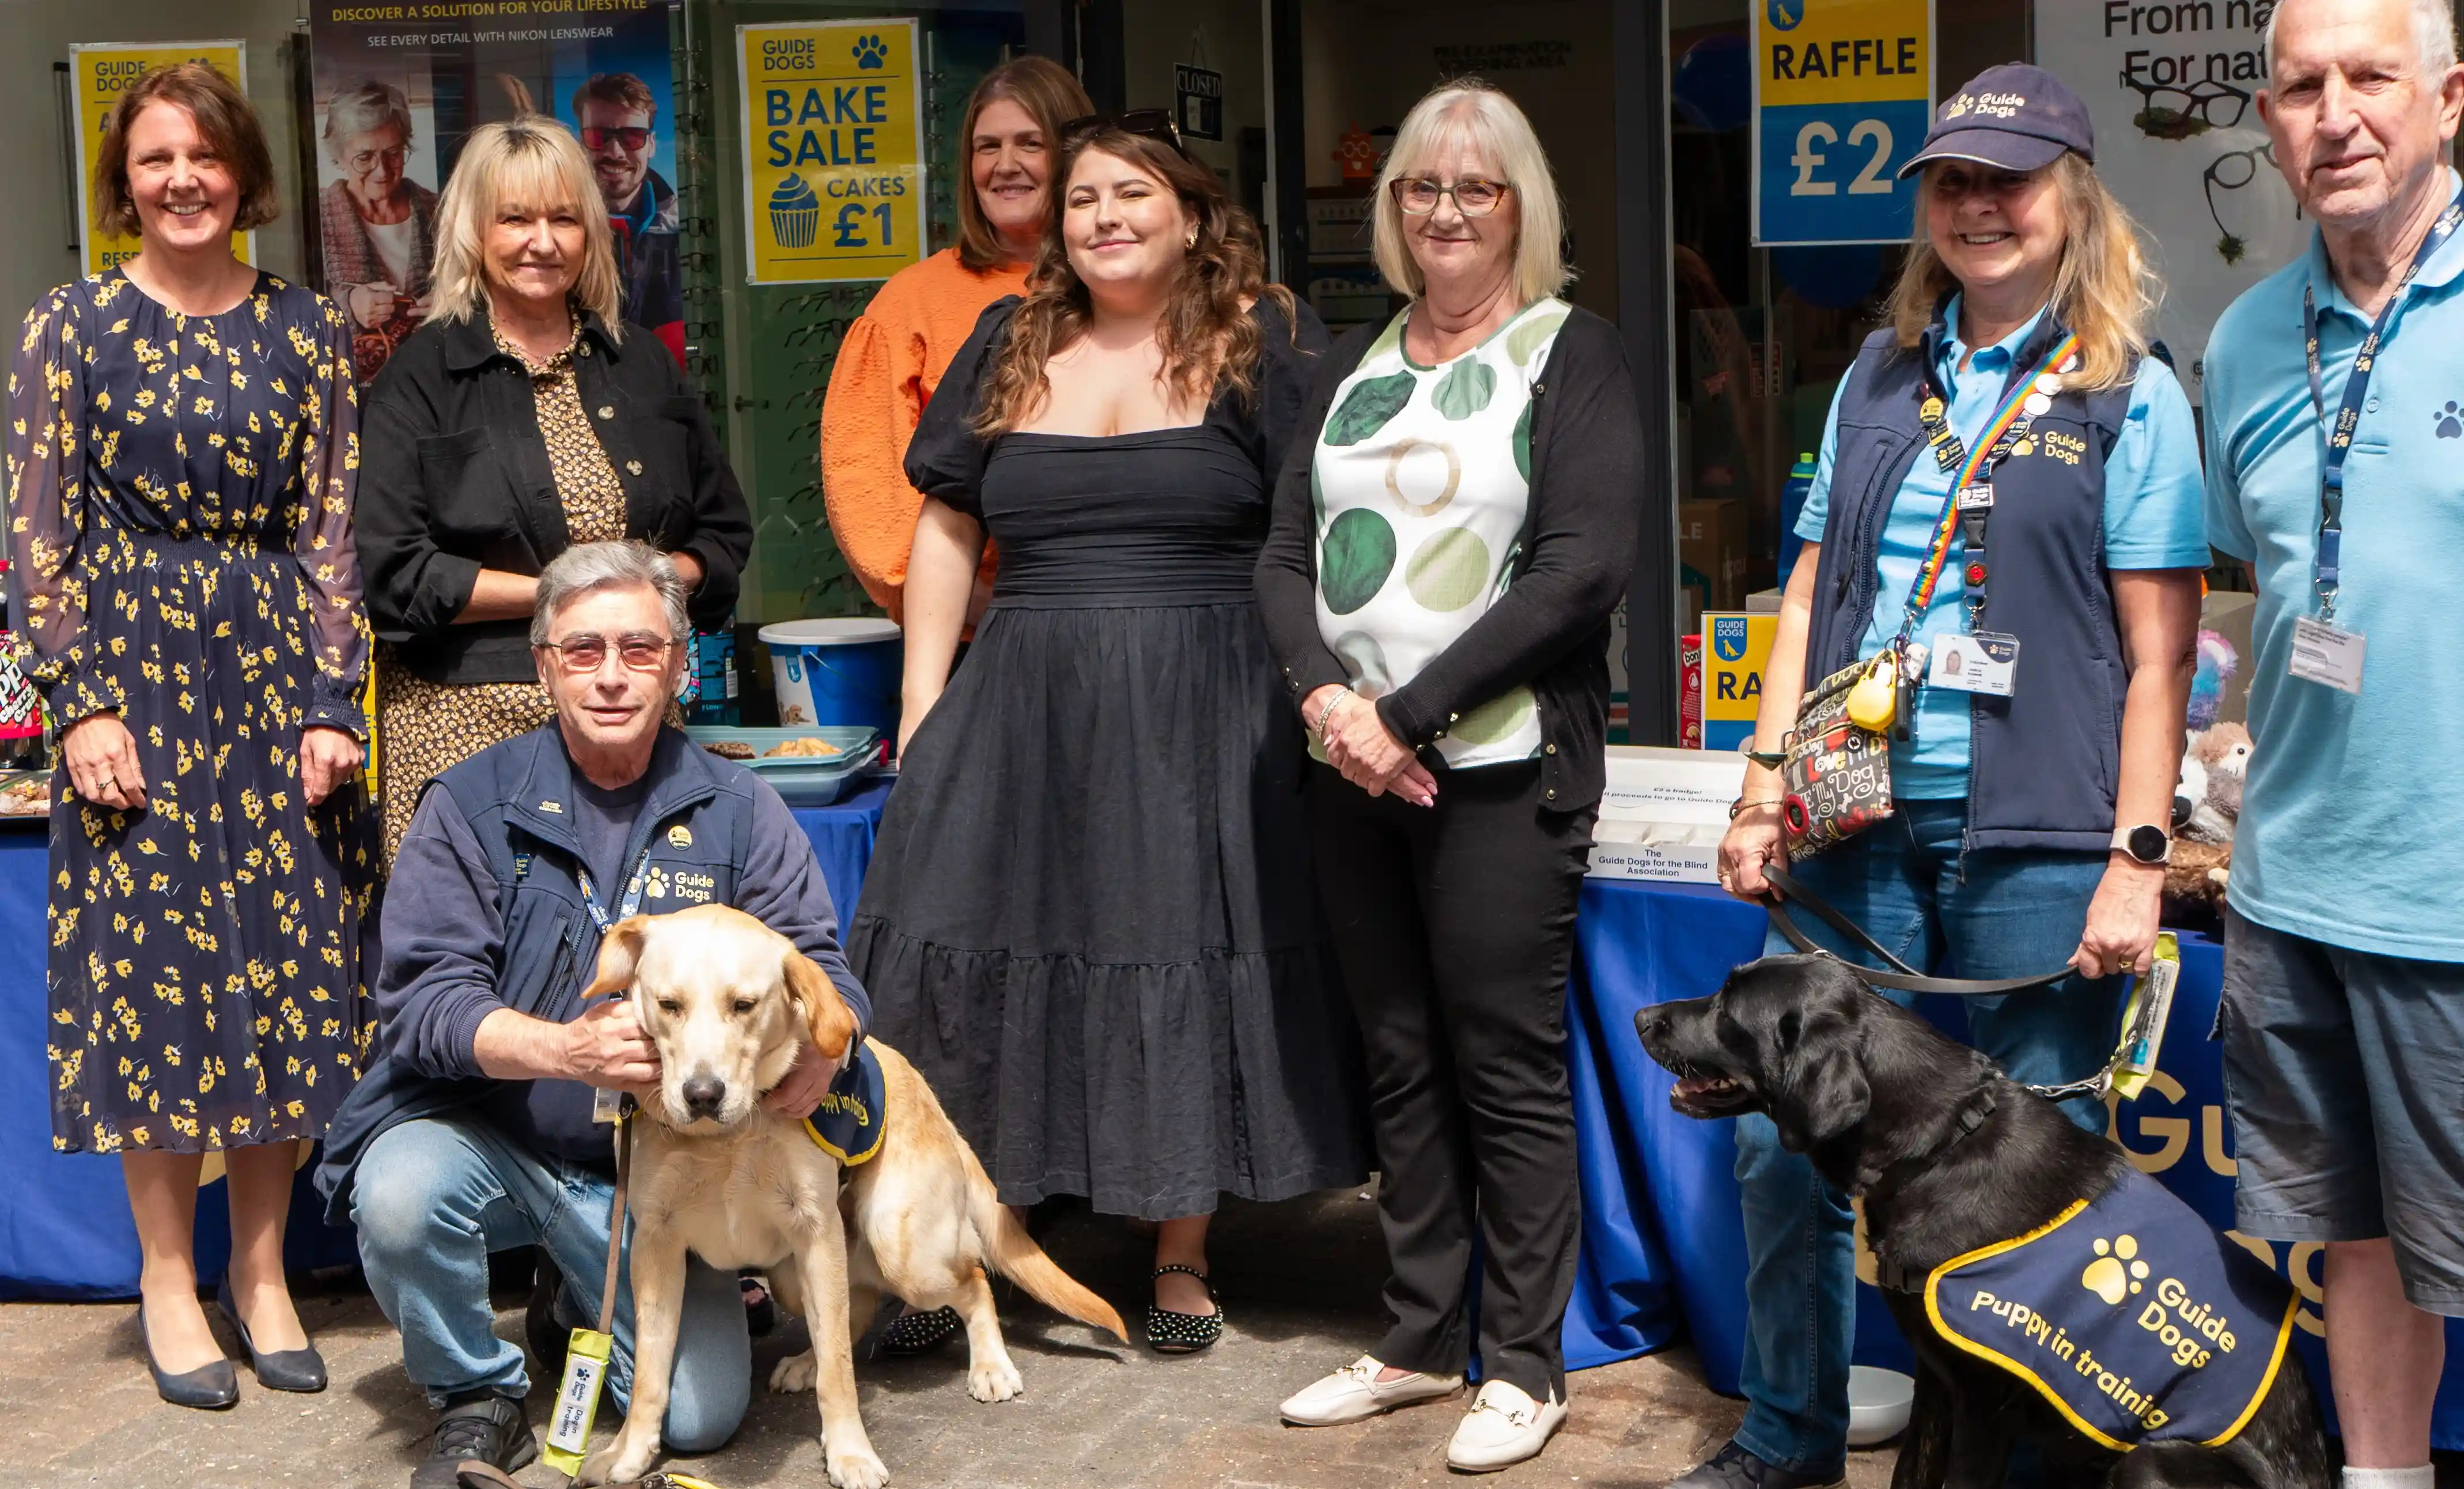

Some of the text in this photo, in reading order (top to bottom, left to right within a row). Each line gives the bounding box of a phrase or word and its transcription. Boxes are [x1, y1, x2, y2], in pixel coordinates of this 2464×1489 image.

[332, 0, 647, 21] DISCOVER A SOLUTION FOR YOUR LIFESTYLE
[2105, 0, 2213, 37] From
[368, 27, 614, 47] SEE EVERY DETAIL WITH NIKON LENSWEAR
[762, 39, 816, 55] GUIDE
[763, 54, 815, 70] DOGS
[1772, 37, 1917, 80] RAFFLE
[2125, 50, 2195, 86] For
[1177, 70, 1221, 98] CLOSED
[766, 86, 888, 126] BAKE
[1974, 103, 2016, 118] Dogs
[1979, 92, 2026, 107] Guide
[767, 129, 876, 168] SALE
[1791, 119, 1893, 196] £2
[827, 176, 906, 199] CAKES
[833, 203, 892, 248] £1
[2045, 430, 2085, 453] Guide
[2044, 443, 2079, 465] Dogs
[1717, 621, 1745, 629] GUIDE
[1718, 629, 1744, 637] DOGS
[1599, 856, 1625, 864] Guide
[1627, 857, 1651, 868] Dogs
[1653, 859, 1665, 867] for
[1685, 861, 1708, 870] Blind
[1645, 849, 1661, 857] The
[675, 871, 714, 888] Guide
[1627, 867, 1679, 877] Association
[675, 885, 710, 903] Dogs
[820, 1093, 841, 1115] uppy
[2157, 1277, 2238, 1354] Guide
[2137, 1301, 2211, 1370] Dogs
[1970, 1290, 2170, 1431] Puppy in training
[559, 1406, 573, 1437] training
[571, 1409, 583, 1426] Dog
